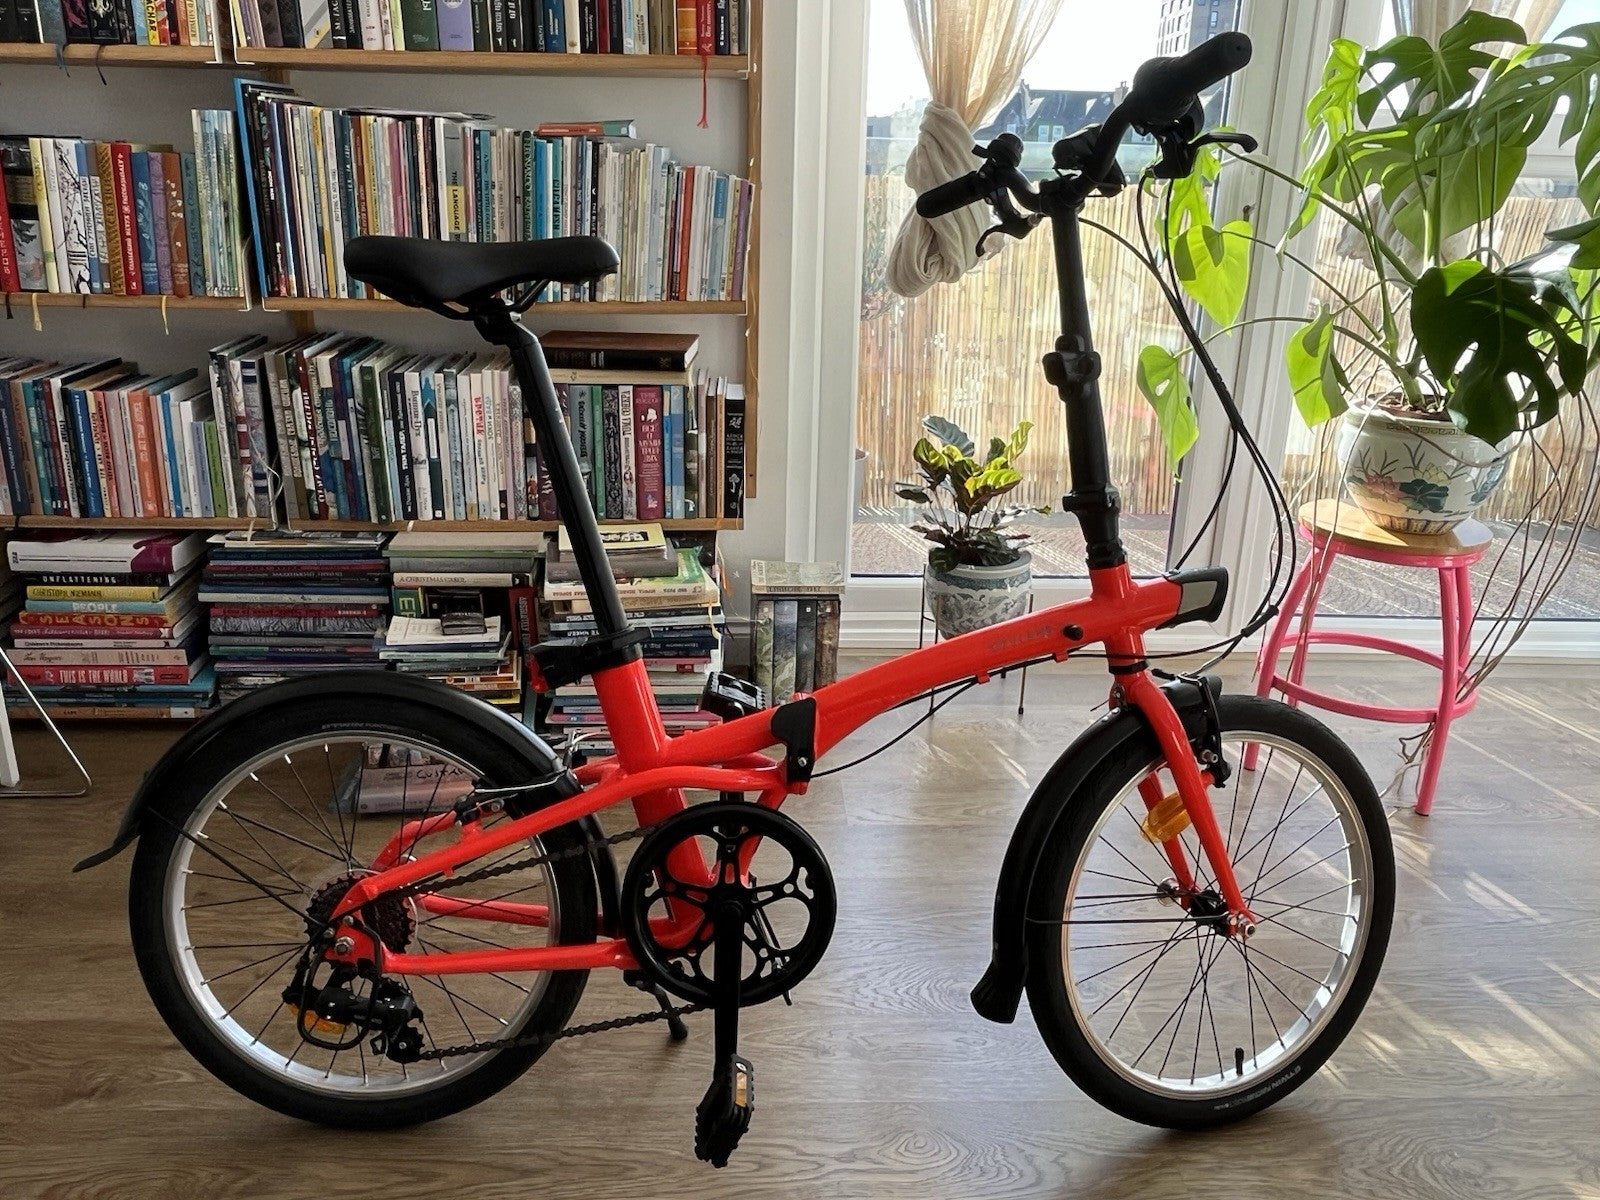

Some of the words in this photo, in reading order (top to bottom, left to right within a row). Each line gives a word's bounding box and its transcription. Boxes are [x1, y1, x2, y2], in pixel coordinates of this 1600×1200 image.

[452, 189, 460, 231] LANGUAGE
[42, 576, 117, 584] UNFLATTENING
[72, 602, 118, 612] PEOPLE
[40, 613, 149, 626] SEASONS
[59, 670, 77, 684] THIS
[78, 670, 86, 684] IS
[88, 670, 101, 684] THE
[103, 669, 129, 683] WORLD
